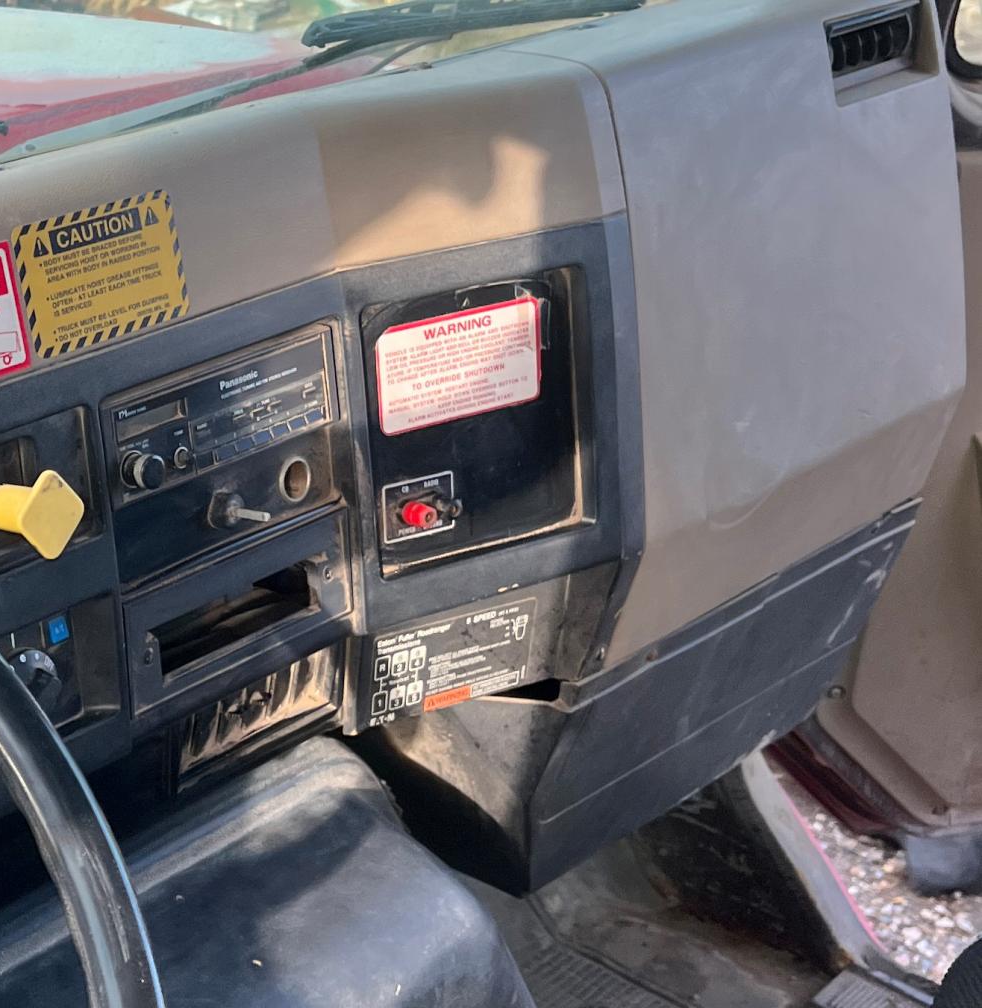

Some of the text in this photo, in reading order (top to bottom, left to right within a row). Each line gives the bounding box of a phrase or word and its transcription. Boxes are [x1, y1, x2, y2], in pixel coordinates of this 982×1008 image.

[56, 212, 134, 248] CAUTION
[423, 316, 492, 340] WARNING
[219, 370, 258, 392] Panasonic
[413, 363, 504, 391] TO OVERRIDE SHUTDOWN
[474, 611, 496, 623] SPEED
[379, 664, 386, 673] R
